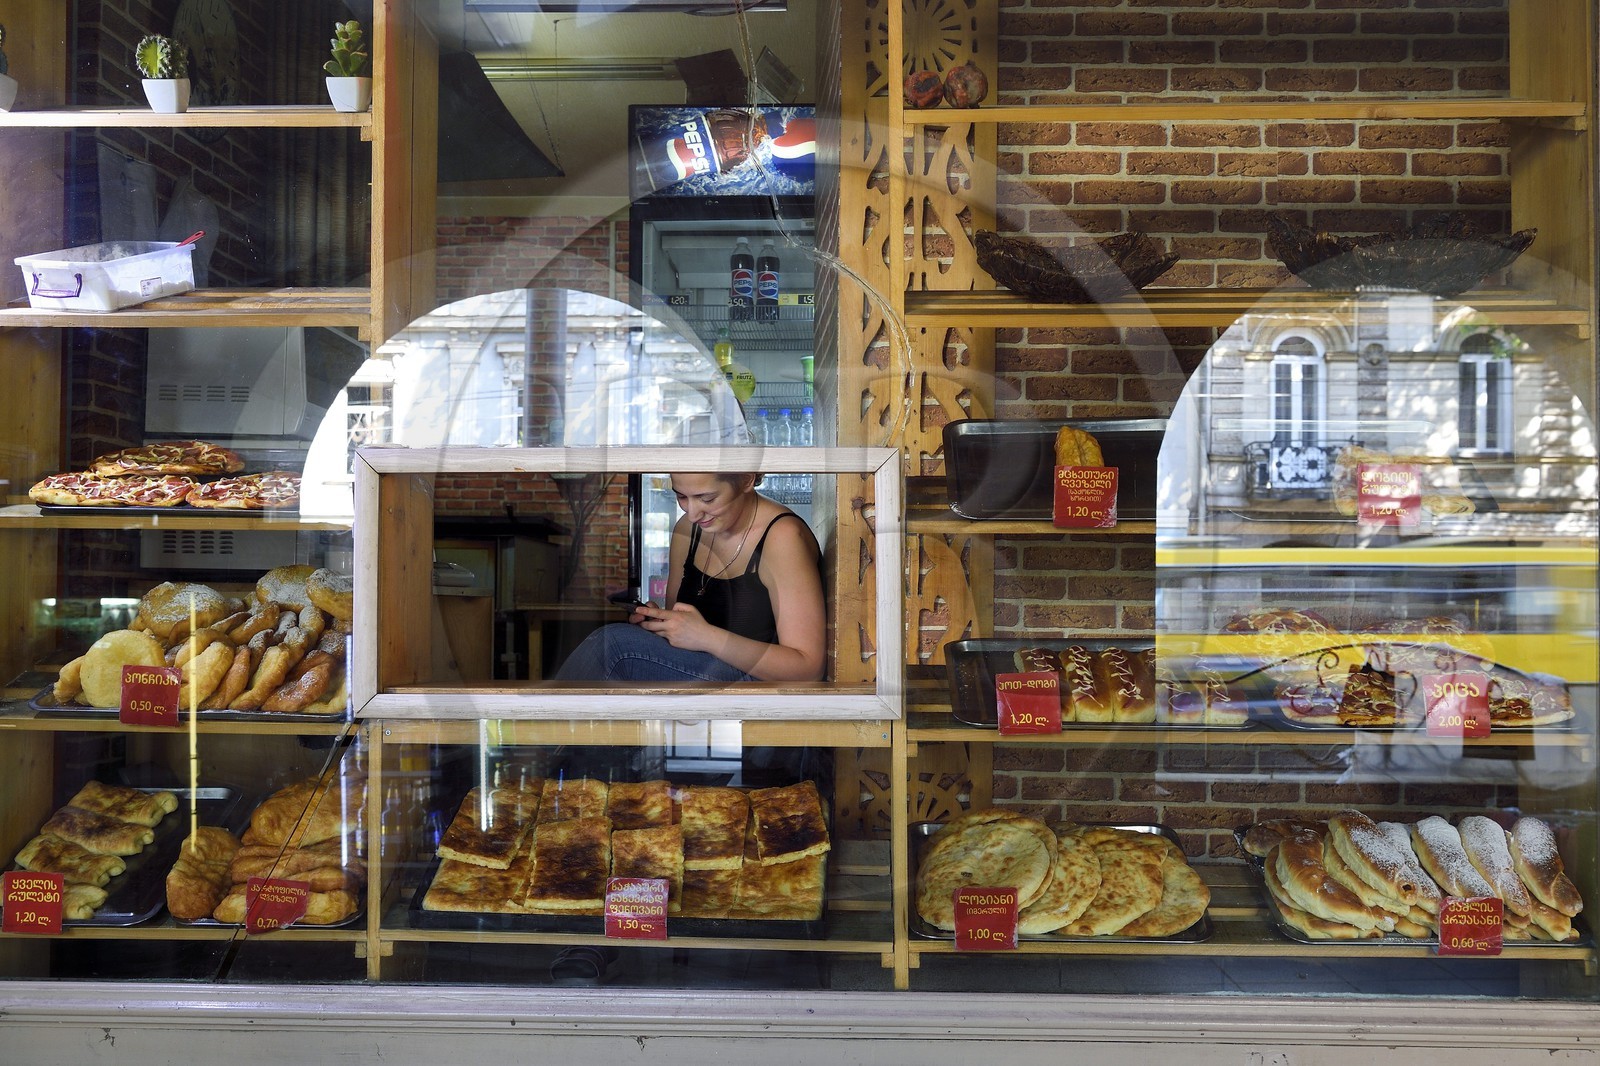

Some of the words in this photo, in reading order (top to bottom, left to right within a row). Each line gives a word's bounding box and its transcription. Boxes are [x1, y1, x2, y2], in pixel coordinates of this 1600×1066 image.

[680, 121, 710, 175] PEPSI
[1058, 470, 1115, 480] მცხეთური
[1061, 479, 1112, 489] ღვეზელი
[1067, 506, 1089, 518] 1,20
[1370, 505, 1392, 516] 1,20
[124, 672, 179, 686] პონჩიკი
[1432, 682, 1480, 698] პიცა
[130, 700, 152, 712] 0,50
[153, 705, 167, 715] ლ.
[1010, 713, 1032, 726] 1,20
[1034, 716, 1049, 727] ლ.
[1439, 715, 1461, 728] 2,00
[1464, 719, 1479, 729] ლ.
[12, 879, 57, 891] ყველის
[611, 882, 665, 893] ხაჭაპური
[8, 891, 60, 903] რულეტი
[260, 893, 298, 904] ღვეზელი
[959, 894, 1014, 905] ლობიანი
[609, 904, 663, 916] ფენოვანი
[967, 907, 1007, 915] (იმერული)
[1448, 902, 1494, 912] ვაშლის
[15, 911, 36, 924] 1,20
[37, 916, 52, 926] ლ.
[257, 917, 279, 929] 0,70
[1442, 914, 1500, 926] კრუასანი
[617, 919, 639, 930] 1,50
[640, 923, 655, 934] ლ.
[968, 928, 990, 941] 1,00
[992, 932, 1007, 942] ლ.
[1451, 937, 1474, 950] 0,60
[1476, 941, 1491, 951] ლ.
